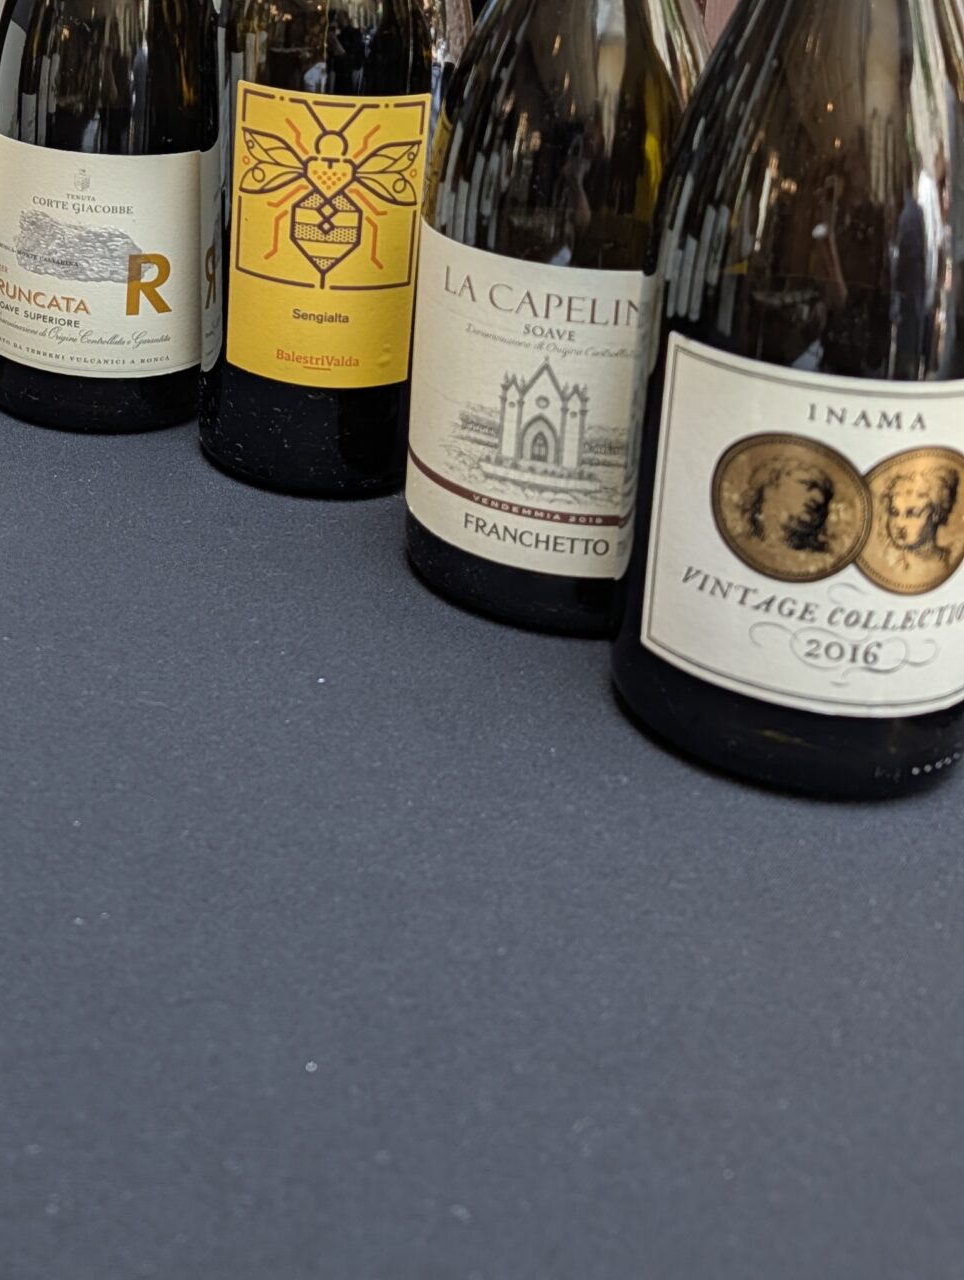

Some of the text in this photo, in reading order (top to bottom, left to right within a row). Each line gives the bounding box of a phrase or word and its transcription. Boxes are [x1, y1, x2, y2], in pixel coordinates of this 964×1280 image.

[32, 195, 134, 215] CORTE GIACOBBE
[66, 193, 96, 202] TENUTA
[126, 253, 172, 316] R
[443, 265, 477, 303] LA
[23, 310, 81, 329] SUPERIORE
[292, 308, 350, 325] Sengialta
[48, 326, 78, 345] Origine
[79, 329, 126, 346] Controllata
[523, 323, 576, 342] SOAVE
[25, 346, 65, 360] TERRENI
[69, 356, 126, 365] VULCANICI
[276, 348, 359, 368] BalestriValda
[807, 403, 928, 431] INAMA
[472, 494, 562, 521] VENDEMMIA
[464, 512, 610, 557] FRANCHETTO
[683, 566, 820, 623] VINTAGE
[804, 638, 883, 666] 2016
